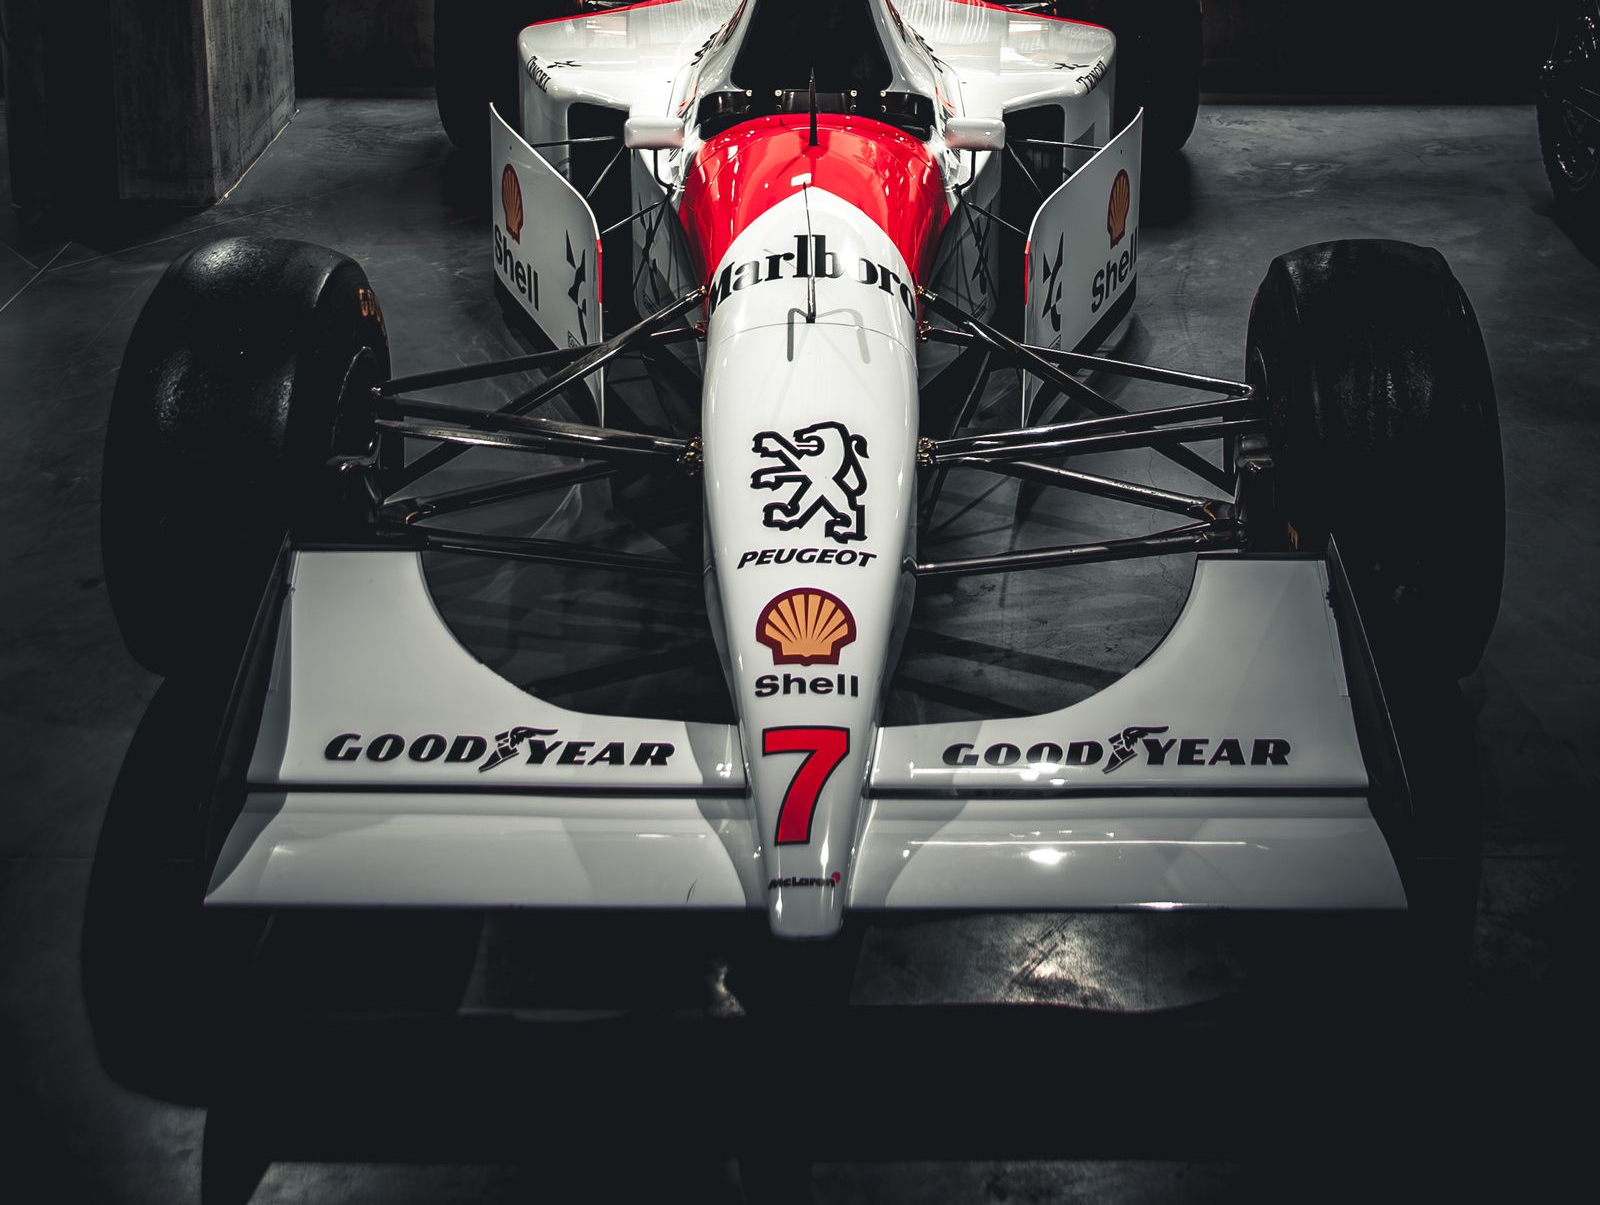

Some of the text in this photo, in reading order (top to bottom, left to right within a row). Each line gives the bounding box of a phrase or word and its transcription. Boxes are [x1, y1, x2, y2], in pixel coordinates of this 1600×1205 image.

[495, 225, 540, 311] Shell
[1091, 229, 1138, 313] Shell
[737, 548, 877, 570] PEUGEOT
[755, 673, 859, 697] Shell
[762, 725, 850, 846] 7
[768, 876, 836, 890] McLaren
